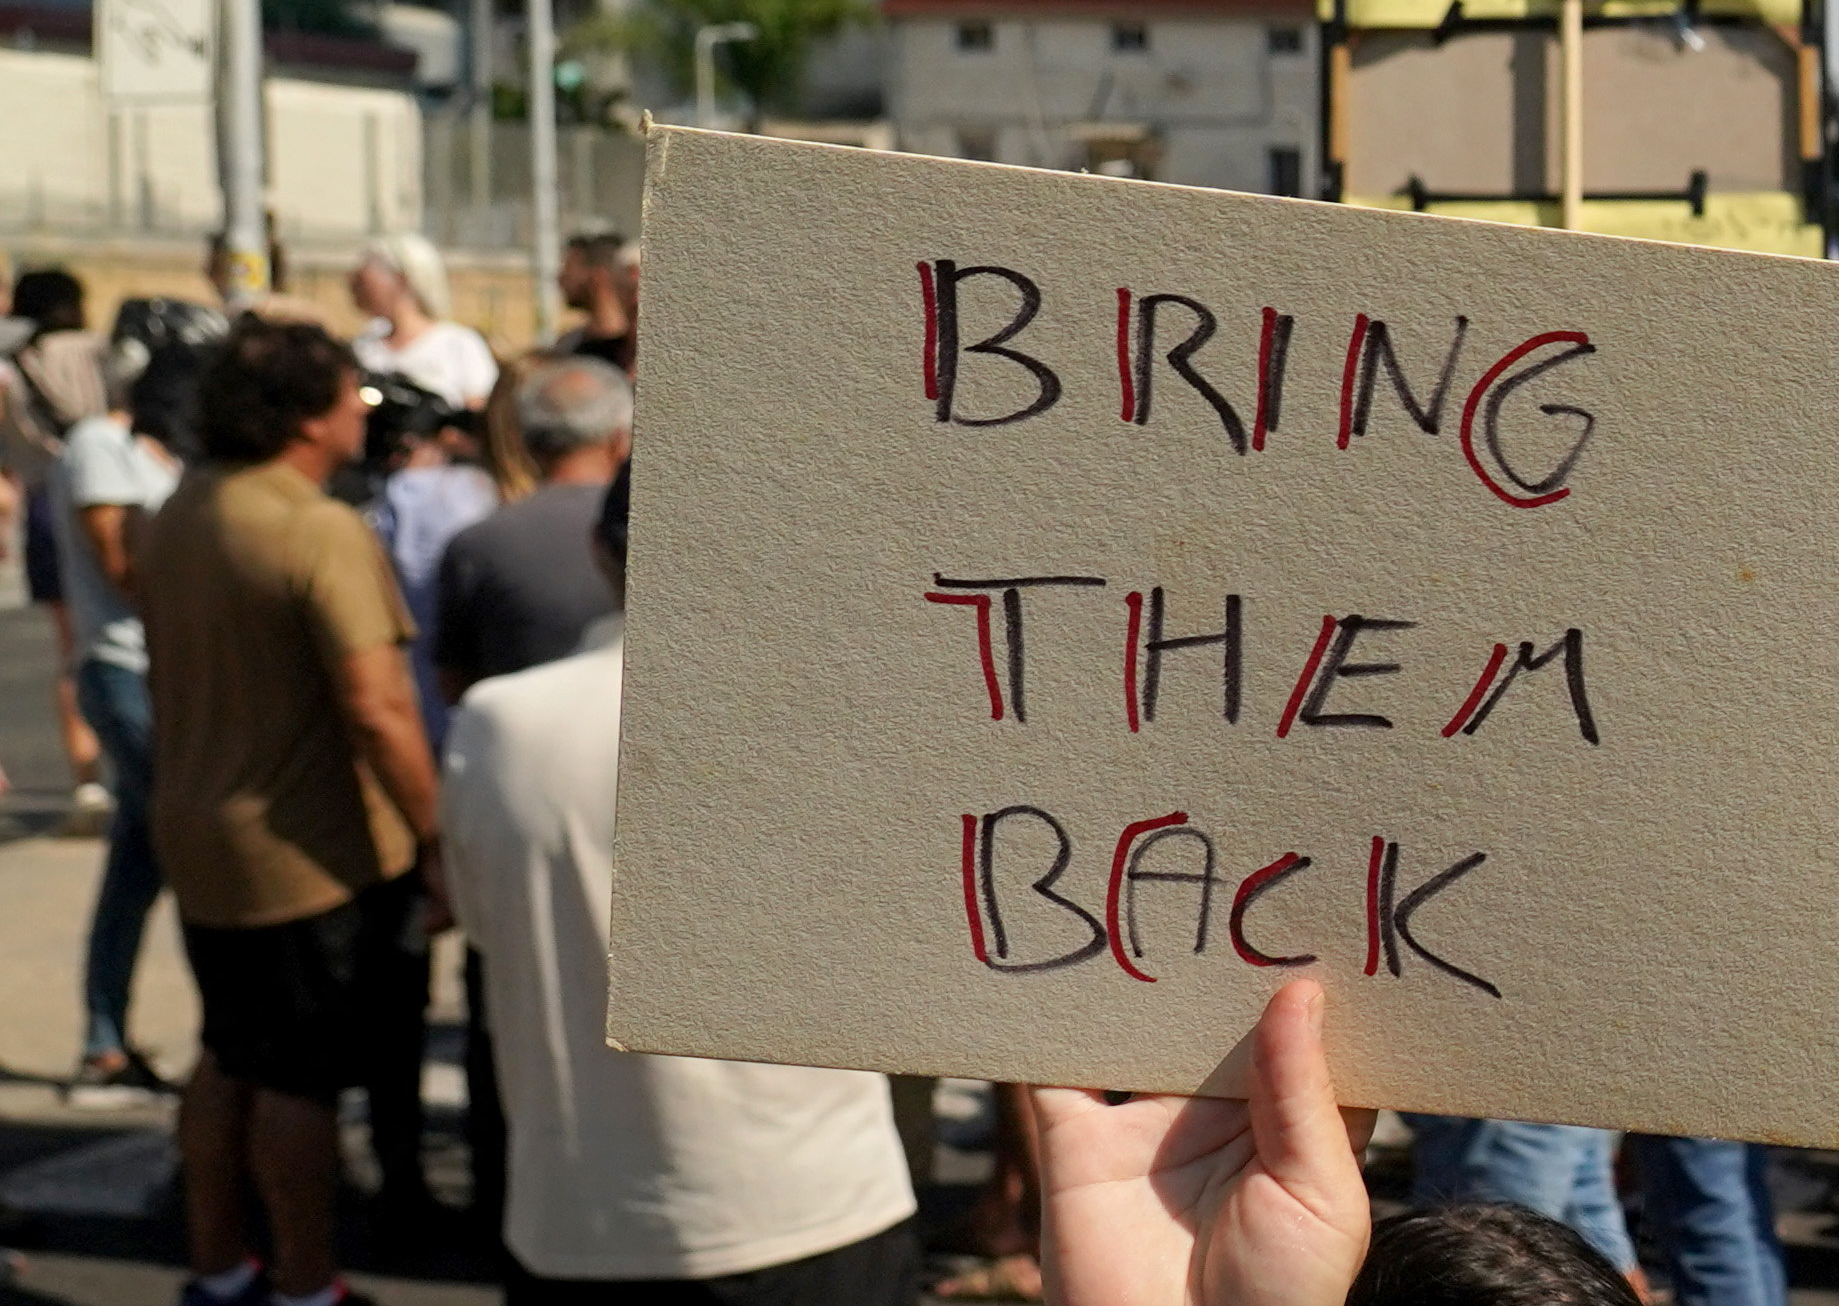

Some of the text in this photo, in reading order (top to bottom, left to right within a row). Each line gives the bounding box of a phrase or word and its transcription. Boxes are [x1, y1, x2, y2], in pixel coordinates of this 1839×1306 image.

[918, 260, 1599, 509] BRING
[925, 574, 1601, 746] THEM
[962, 805, 1503, 999] BACK
